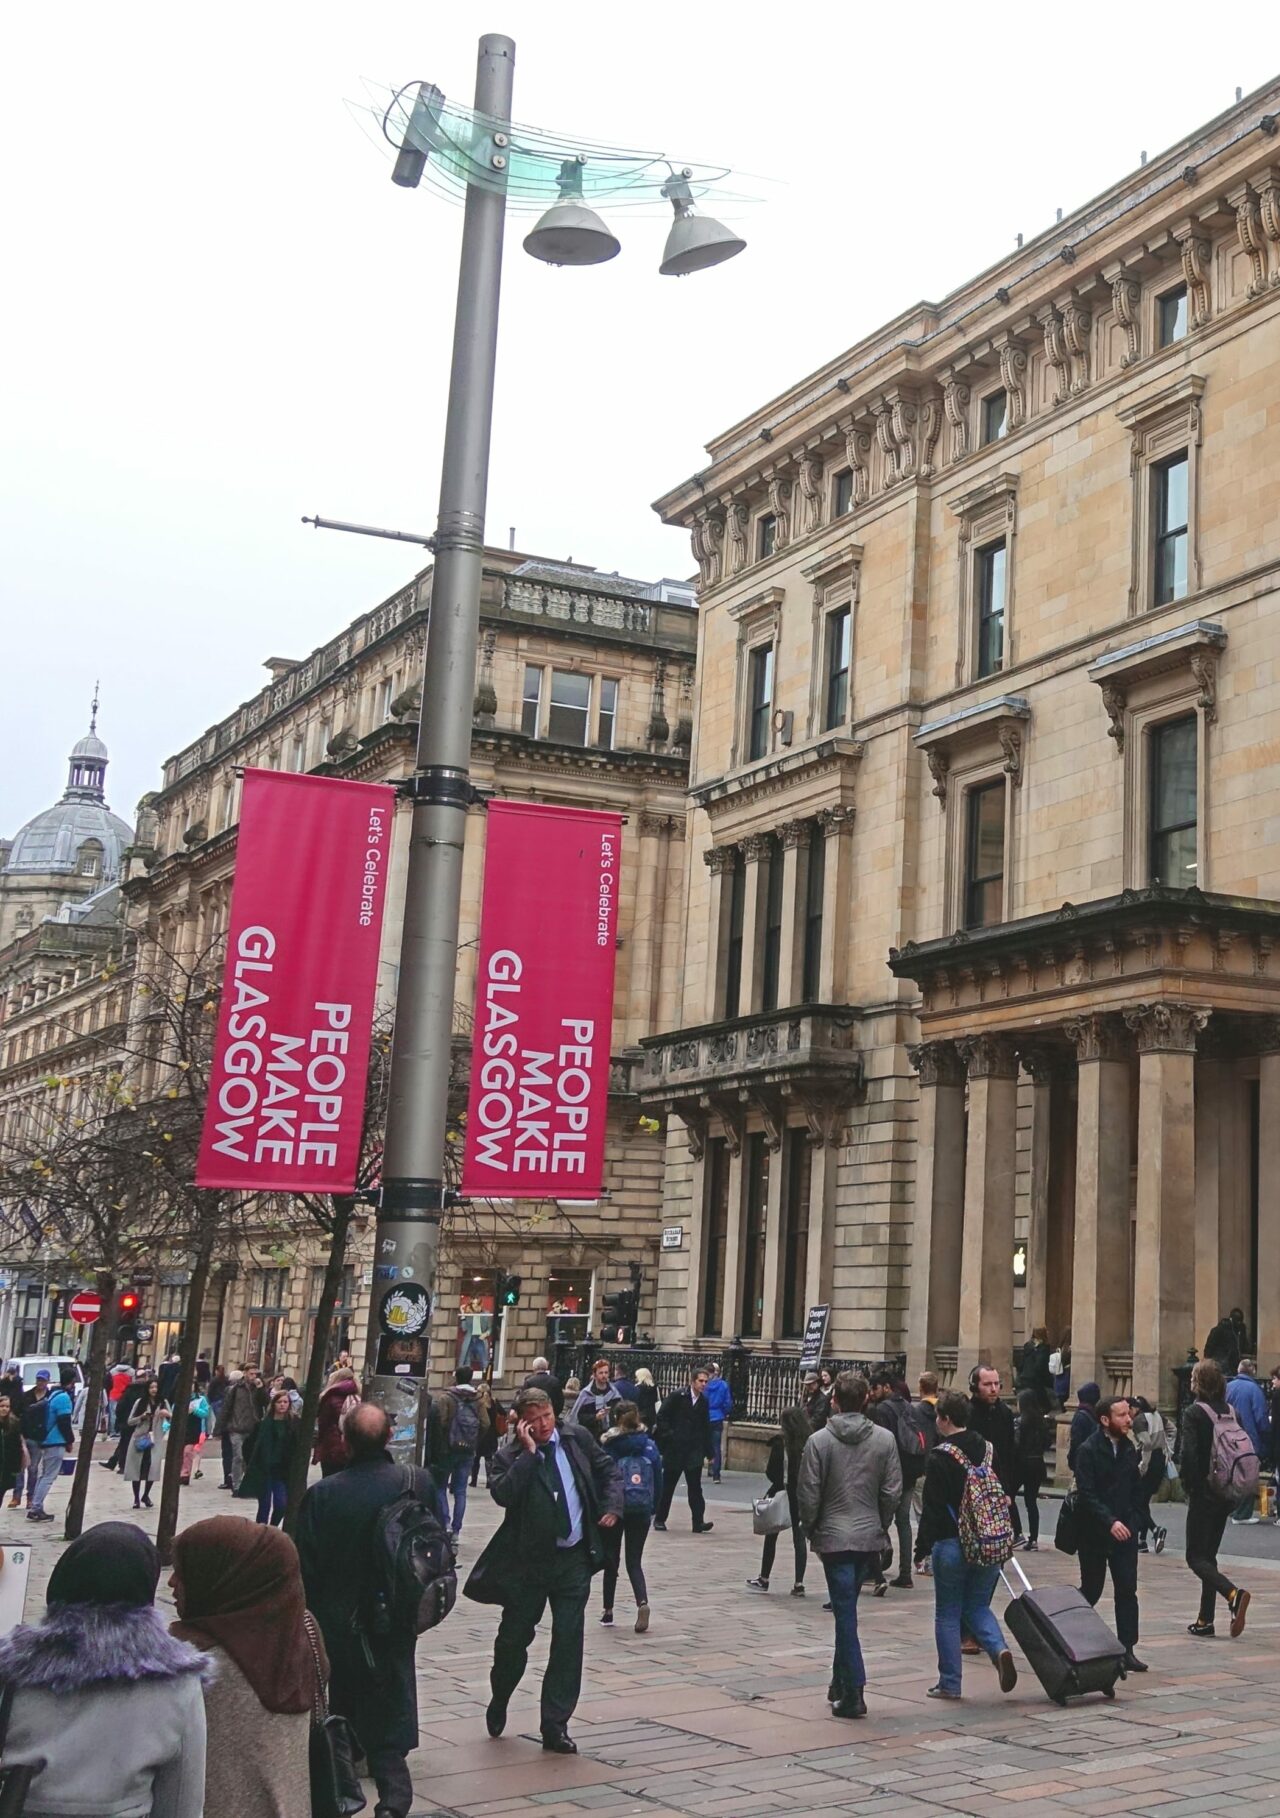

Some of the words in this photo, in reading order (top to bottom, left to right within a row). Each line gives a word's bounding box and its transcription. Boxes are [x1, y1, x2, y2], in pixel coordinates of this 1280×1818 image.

[367, 807, 385, 844] Let's
[600, 833, 615, 868] Let's
[359, 848, 381, 926] Celebrate
[597, 872, 613, 946] Celebrate
[211, 925, 276, 1162] GLASGOW
[474, 949, 523, 1172] GLASGOW
[254, 1033, 306, 1165] MAKE
[297, 1002, 352, 1167] PEOPLE
[512, 1050, 555, 1173] MAKE
[551, 1018, 595, 1174] PEOPLE
[805, 1332, 821, 1340] Repairs
[809, 1310, 826, 1318] Cheaper
[809, 1320, 821, 1329] Apple
